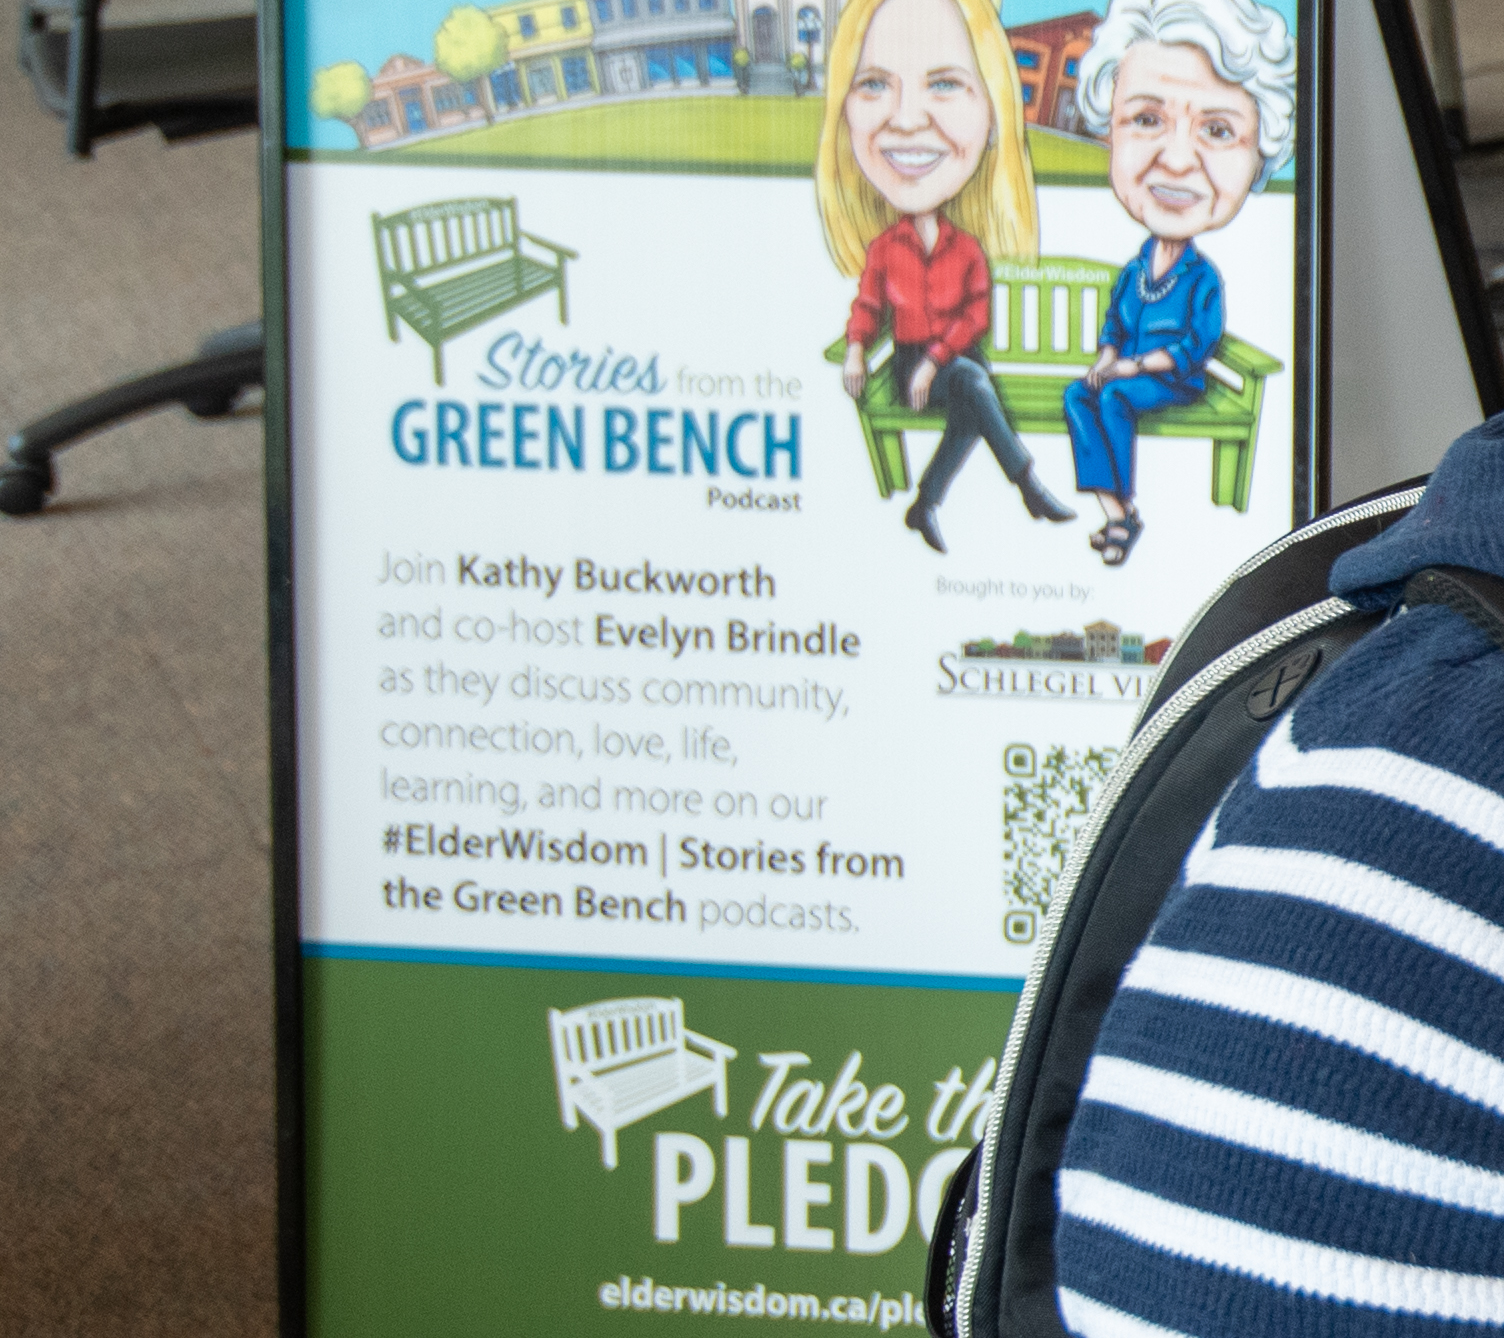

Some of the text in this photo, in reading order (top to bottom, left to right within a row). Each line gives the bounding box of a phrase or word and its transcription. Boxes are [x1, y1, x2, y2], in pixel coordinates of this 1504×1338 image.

[477, 329, 803, 400] Stories from the
[391, 397, 803, 480] GREEN BENCH
[706, 486, 803, 513] Podcast
[377, 550, 776, 599] Join Kathy Buckworth
[936, 575, 1004, 602] Brought
[1009, 580, 1028, 598] to
[1033, 582, 1065, 605] you
[377, 608, 861, 659] and co-host Evelyn Brindle
[380, 660, 850, 722] as they discuss community,
[938, 651, 1104, 698] SCHLEGEL
[380, 720, 738, 767] connection, love, life,
[380, 766, 829, 822] learning, and more on our
[382, 823, 648, 868] #ElderWisdom
[679, 836, 807, 876] Stories
[816, 841, 905, 880] from
[383, 875, 861, 935] the Green Bench podcasts.
[752, 1050, 909, 1140] Take
